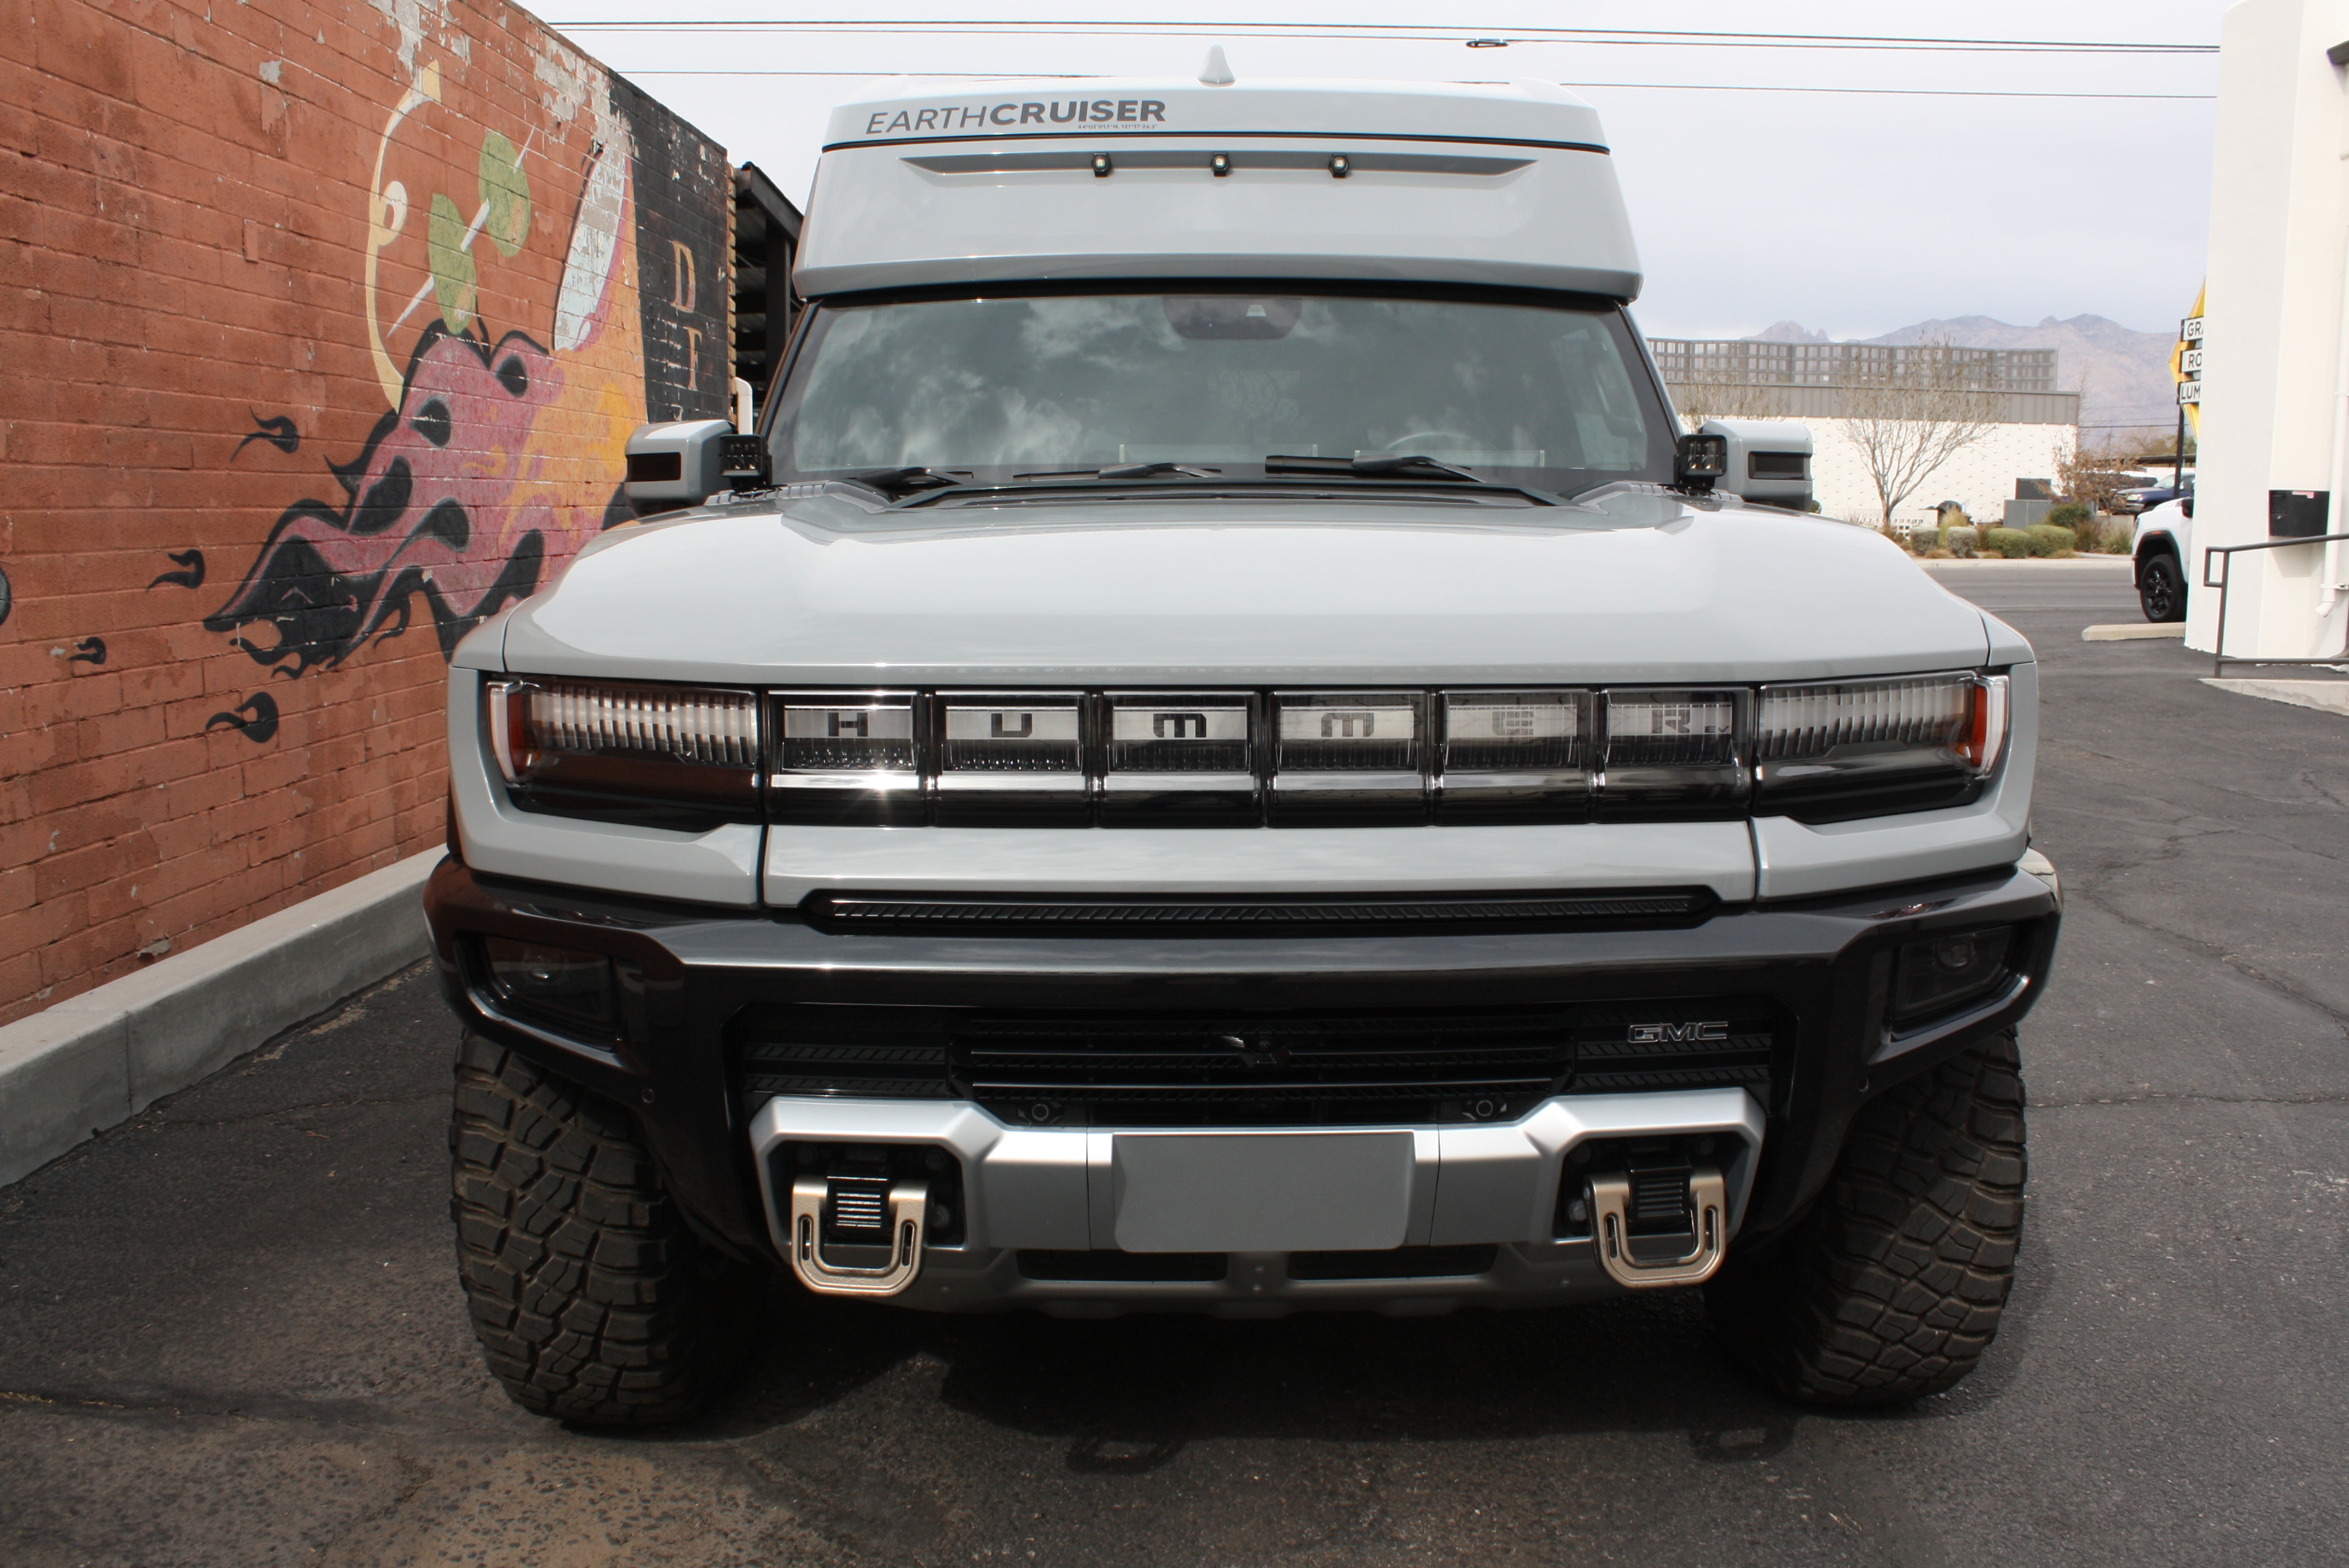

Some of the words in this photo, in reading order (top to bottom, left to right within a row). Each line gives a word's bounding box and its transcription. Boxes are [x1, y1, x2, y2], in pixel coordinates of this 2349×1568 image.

[865, 99, 1166, 135] EARTHCRUISER
[2186, 320, 2204, 337] GR
[1627, 1021, 1728, 1043] GMC
